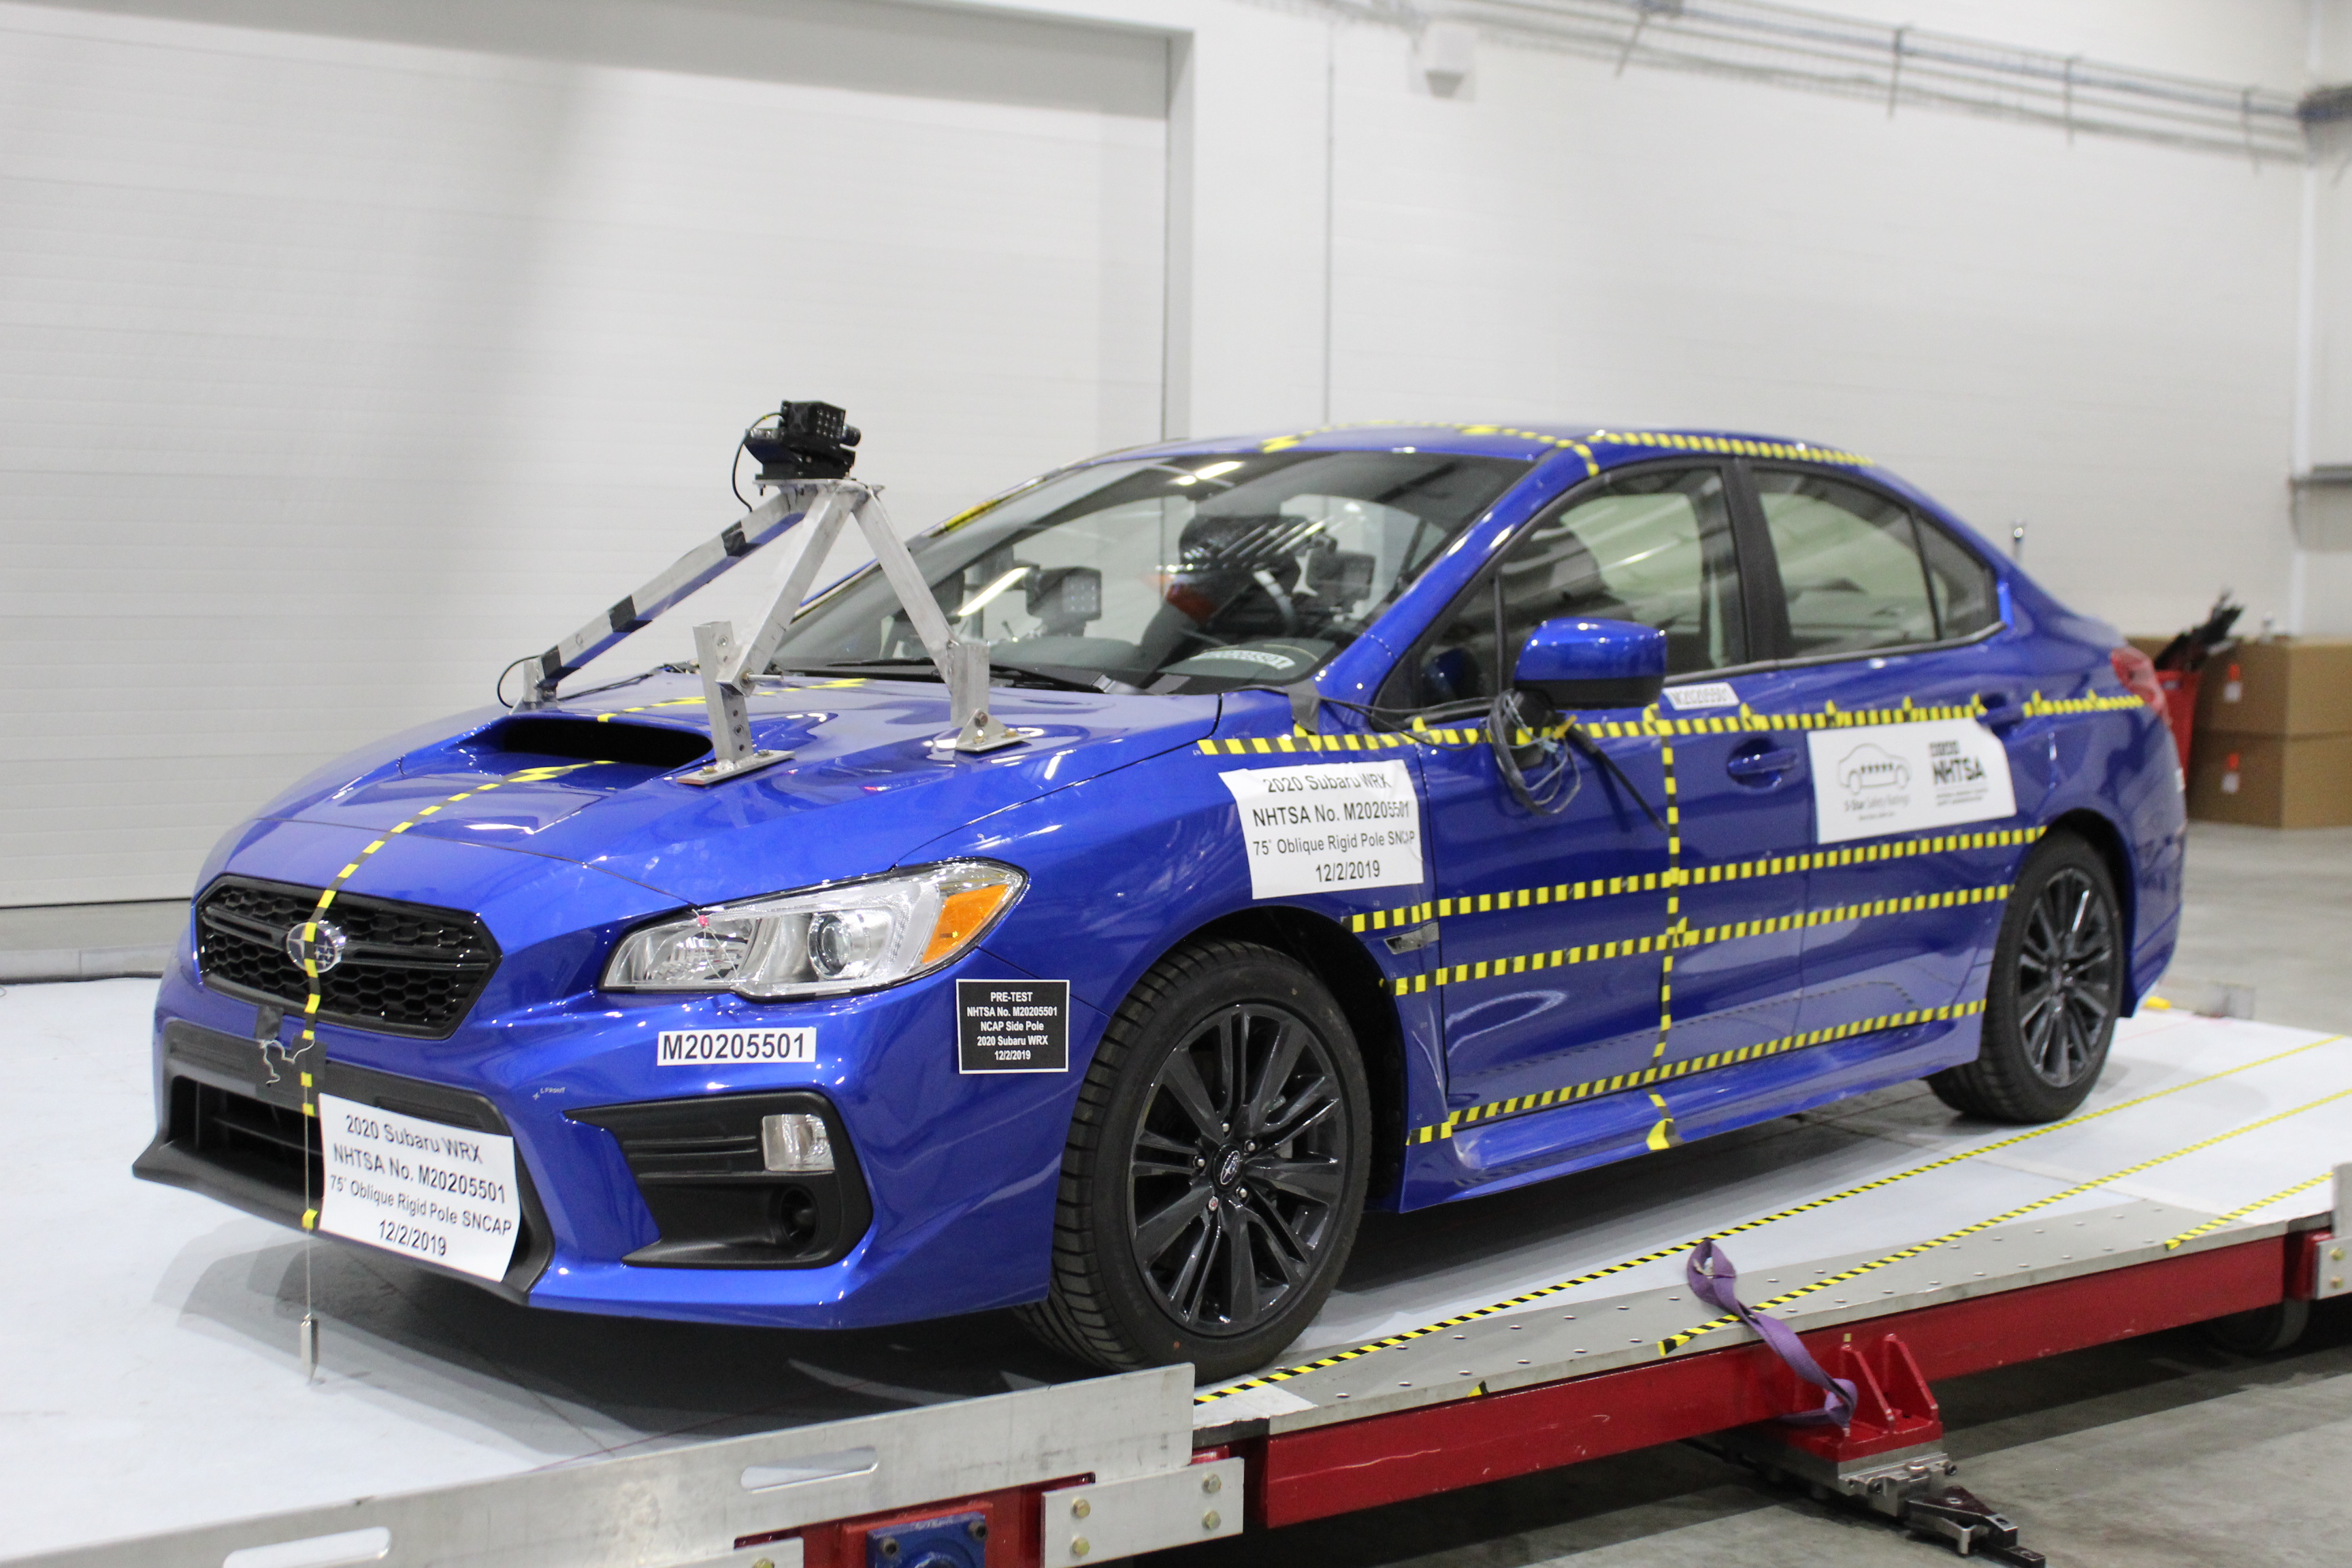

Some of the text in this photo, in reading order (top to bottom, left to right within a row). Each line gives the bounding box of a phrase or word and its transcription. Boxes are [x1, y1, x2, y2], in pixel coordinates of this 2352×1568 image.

[1932, 755, 1987, 785] NHTSA
[1263, 773, 1392, 793] 2020 Subaru WRX
[1252, 800, 1409, 827] NHTSA No. M20205501
[1277, 837, 1324, 855] Oblique
[1328, 834, 1357, 853] Rigid
[1361, 832, 1385, 847] Pole
[1316, 860, 1380, 883] 12/2/2019
[990, 992, 1033, 1002] PRE-TEST
[966, 1006, 1058, 1017] NHTSA No. M20205501
[981, 1021, 1044, 1031] NCAP Side Pole
[662, 1032, 804, 1060] M20205501
[977, 1035, 1048, 1046] 2020 Subaru WRX
[994, 1049, 1031, 1060] 12/2/2019
[346, 1114, 483, 1164] 2020 Subaru WRX
[333, 1143, 506, 1203] NHTSA No. M20205501
[350, 1180, 394, 1207] Oblique
[397, 1193, 427, 1217] Rigid
[430, 1203, 457, 1224] Pole
[462, 1210, 512, 1236] SNCAP
[379, 1220, 446, 1256] 12/2/2019
